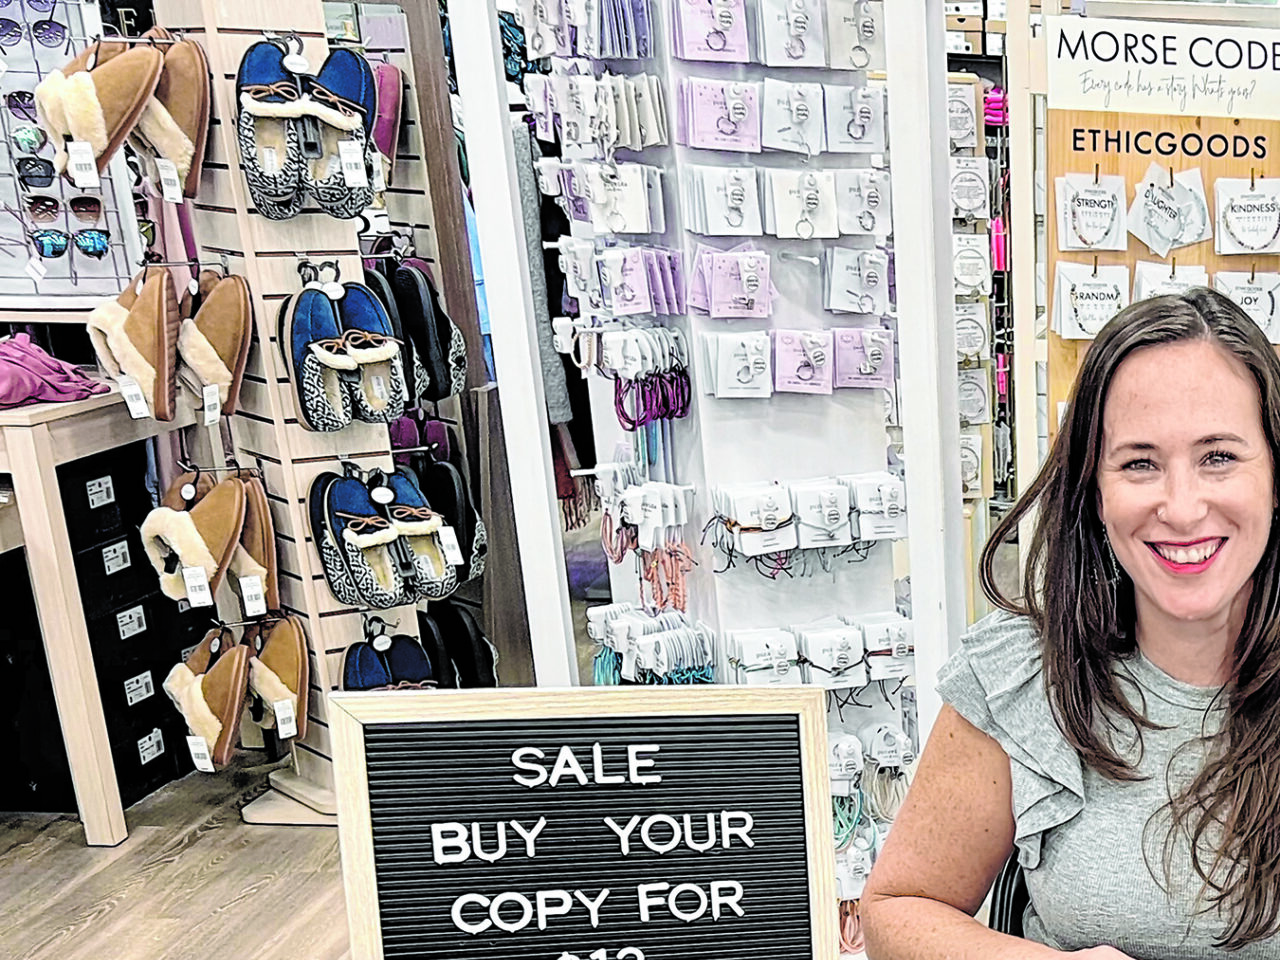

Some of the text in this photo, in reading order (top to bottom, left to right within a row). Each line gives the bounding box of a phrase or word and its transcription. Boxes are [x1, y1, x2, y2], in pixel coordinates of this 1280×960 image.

[1058, 28, 1177, 66] MORSE
[1079, 69, 1112, 108] Every
[1114, 70, 1134, 97] code
[1136, 69, 1152, 97] has
[1072, 128, 1266, 159] ETHICGOODS
[1230, 202, 1276, 213] KINDNESS
[1240, 296, 1258, 306] JOY
[511, 743, 662, 788] SALE
[430, 810, 755, 865] BUY YOUR
[450, 880, 746, 935] COPY FOR
